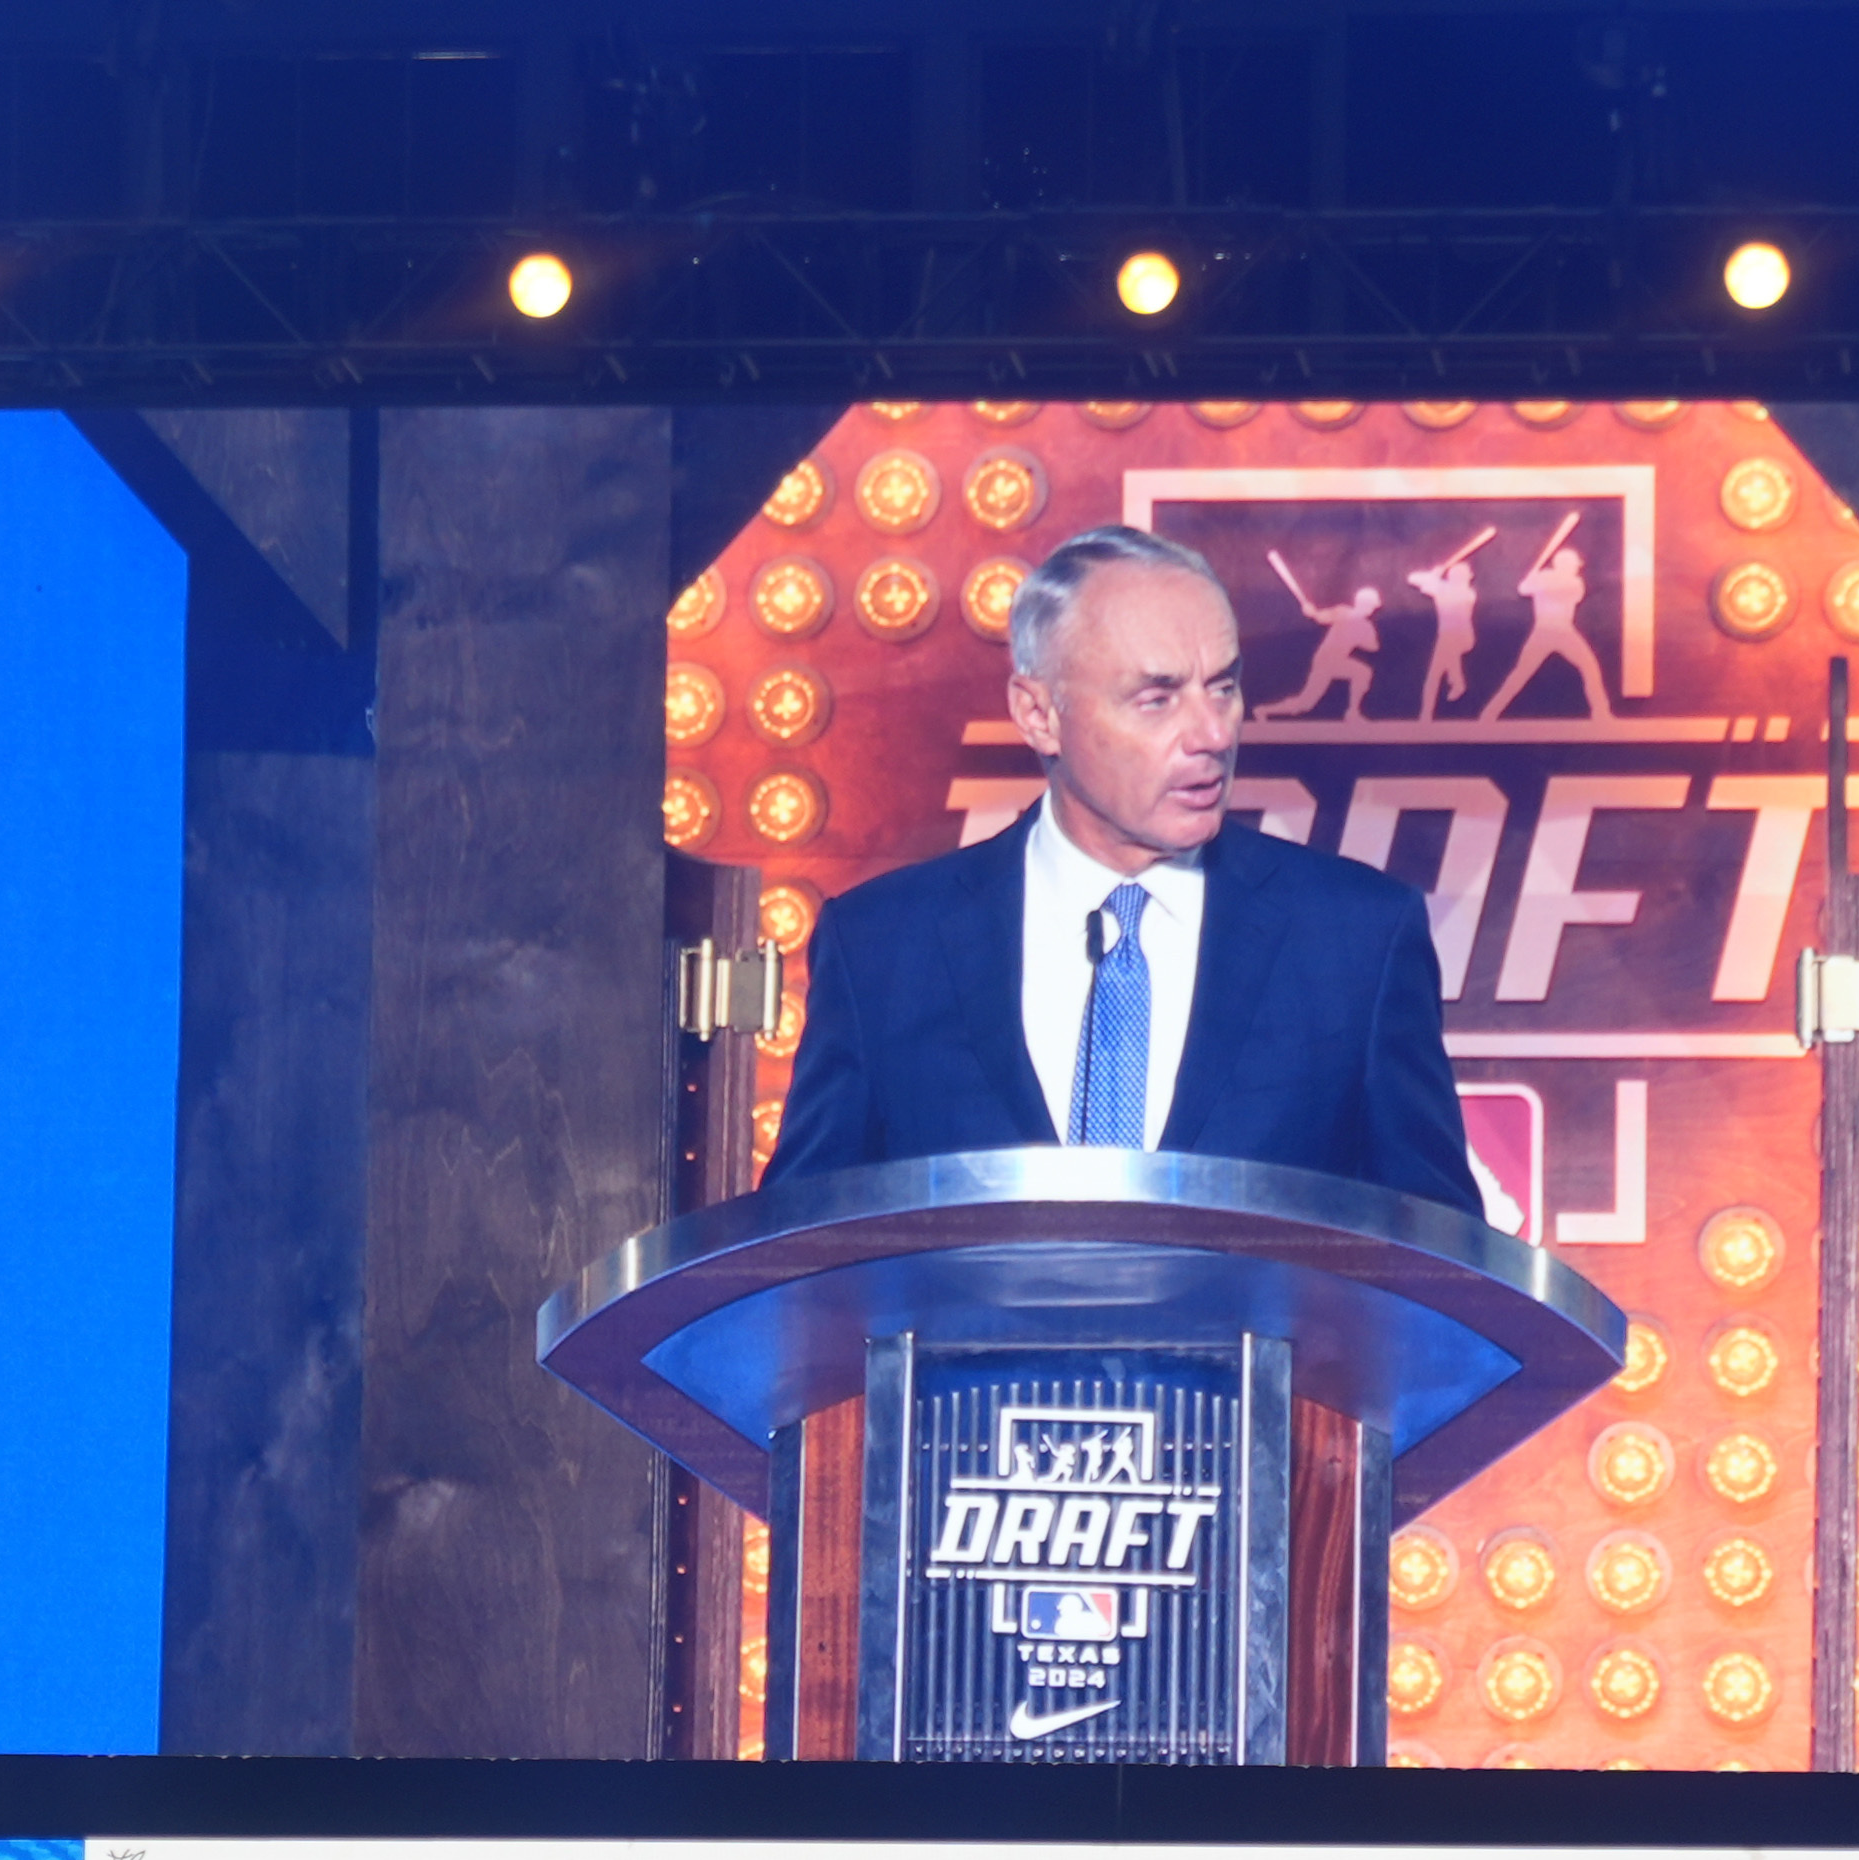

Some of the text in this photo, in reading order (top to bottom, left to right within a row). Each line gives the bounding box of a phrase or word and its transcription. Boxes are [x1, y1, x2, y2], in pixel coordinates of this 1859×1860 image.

[930, 1495, 1217, 1569] DRAFT
[1017, 1644, 1121, 1665] TEXAS
[1028, 1668, 1106, 1688] 2024
